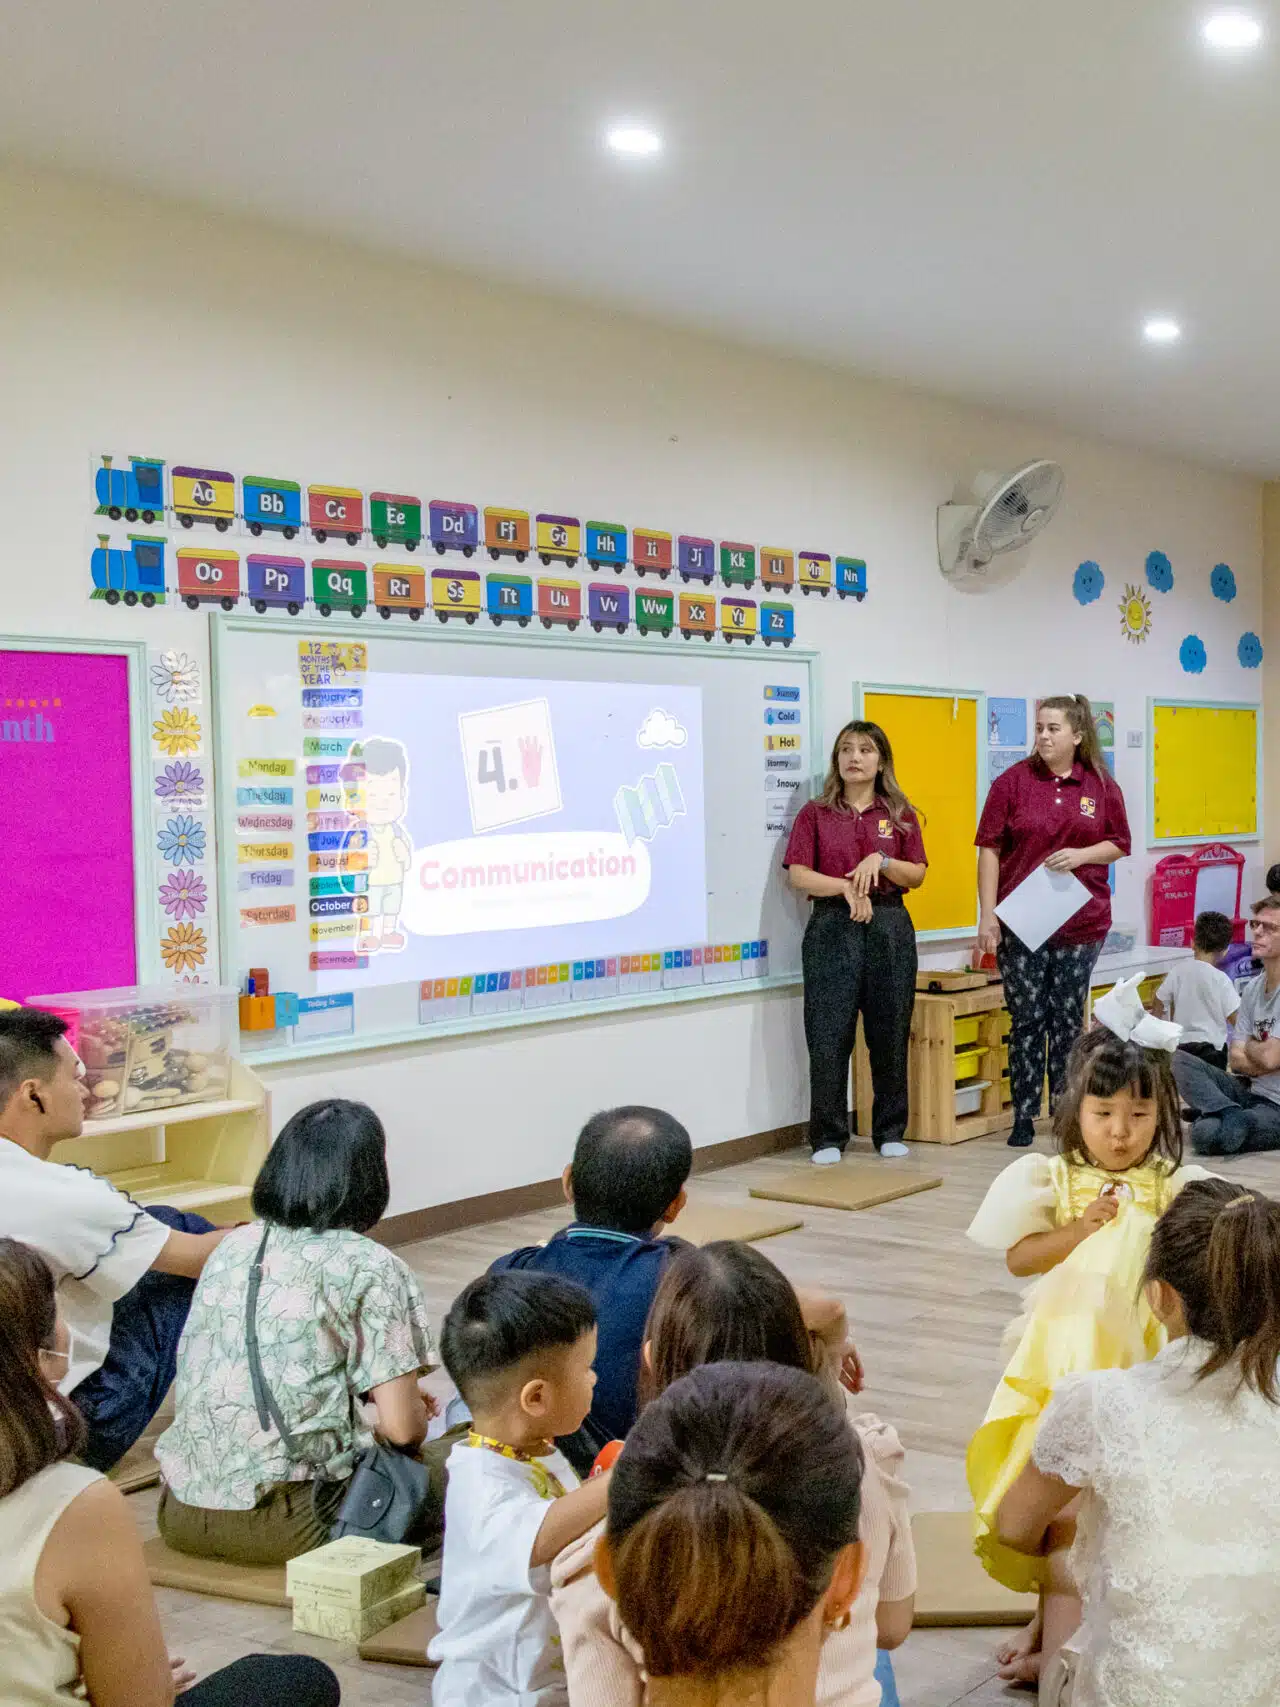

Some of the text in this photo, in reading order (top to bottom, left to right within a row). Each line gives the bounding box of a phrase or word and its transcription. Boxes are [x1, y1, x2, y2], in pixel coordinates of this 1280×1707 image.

[191, 482, 217, 503] Aa
[260, 494, 284, 514] Bb
[324, 501, 347, 519] Cc
[386, 505, 406, 525] Ee
[442, 515, 465, 534] Dd
[500, 521, 516, 542] Ff
[551, 527, 568, 548] Gg
[596, 536, 615, 552] Hh
[647, 541, 657, 557] Ii
[690, 547, 702, 567] Jj
[772, 559, 784, 575] Ll
[805, 562, 824, 577] Mm
[843, 570, 859, 584] Nn
[195, 562, 785, 629] Oo Pp Qq Rr Ss Tt Uu Vv Ww Xx Yy Zz
[308, 643, 322, 655] 12
[300, 655, 330, 665] MONTHS
[301, 664, 331, 673] OF THE
[302, 674, 331, 685] YEAR
[776, 687, 800, 700] Sunny
[777, 711, 795, 721] Cold
[0, 714, 55, 743] nth
[310, 741, 343, 752] March
[779, 737, 795, 747] Hot
[248, 760, 287, 775] Monday
[776, 778, 800, 790] Snowy
[245, 788, 286, 803] Tuesday
[320, 793, 341, 804] May
[238, 816, 293, 829] Wednesday
[766, 823, 786, 831] Windy
[316, 856, 349, 868] August
[419, 848, 638, 890] Communication
[250, 873, 283, 885] Friday
[311, 901, 351, 912] October
[312, 923, 354, 935] November
[312, 955, 357, 965] December
